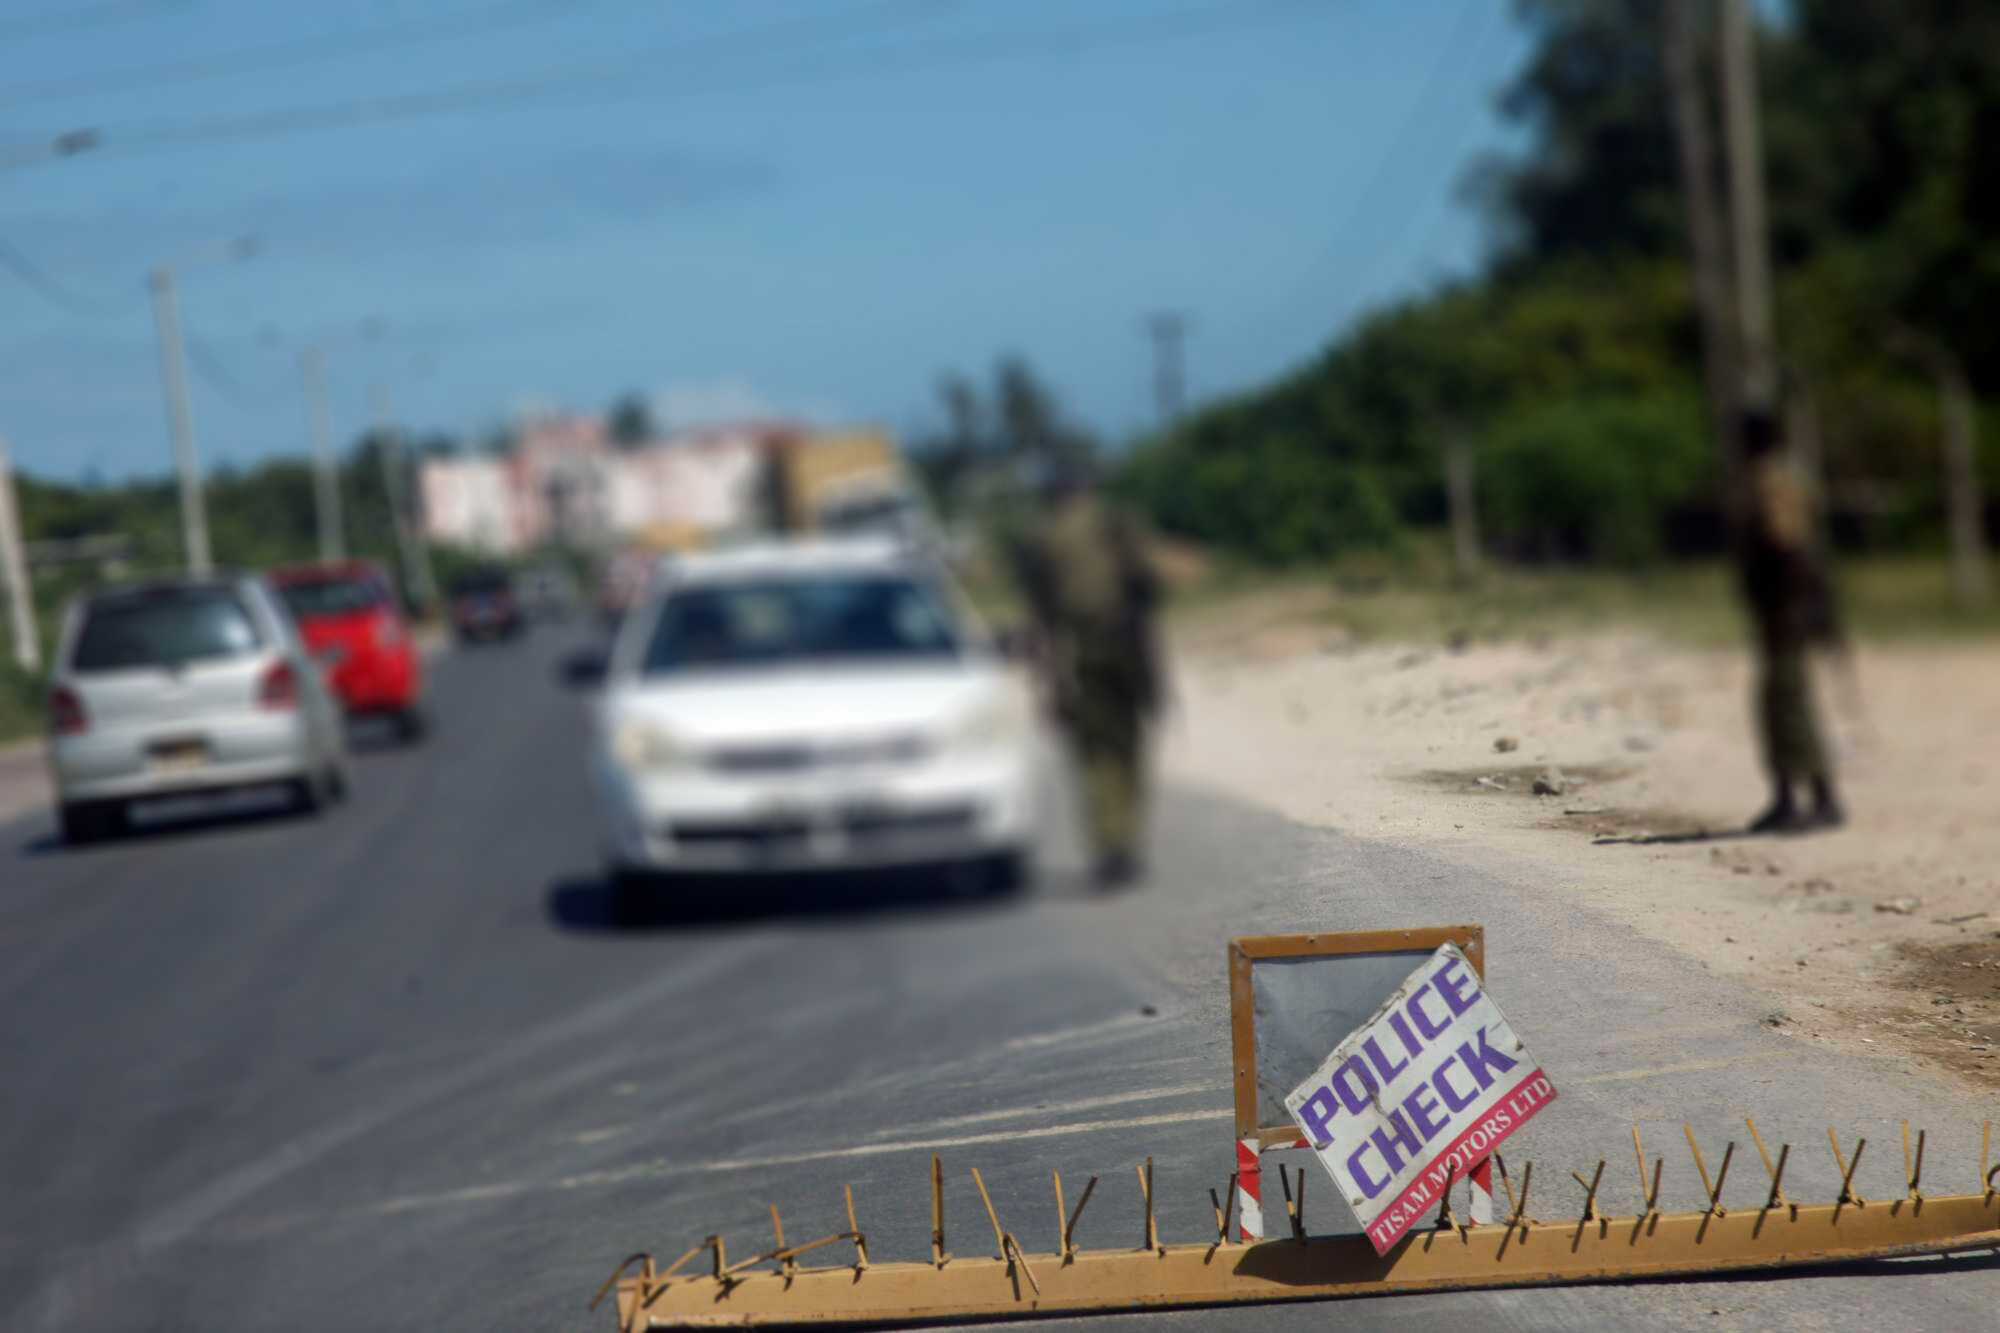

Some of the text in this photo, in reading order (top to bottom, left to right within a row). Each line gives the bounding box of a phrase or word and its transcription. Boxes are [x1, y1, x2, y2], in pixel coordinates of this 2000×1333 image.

[1298, 958, 1482, 1146] POLICE
[1346, 1025, 1519, 1199] CHECK
[1372, 1077, 1551, 1245] TISAM MOTORS LTD
